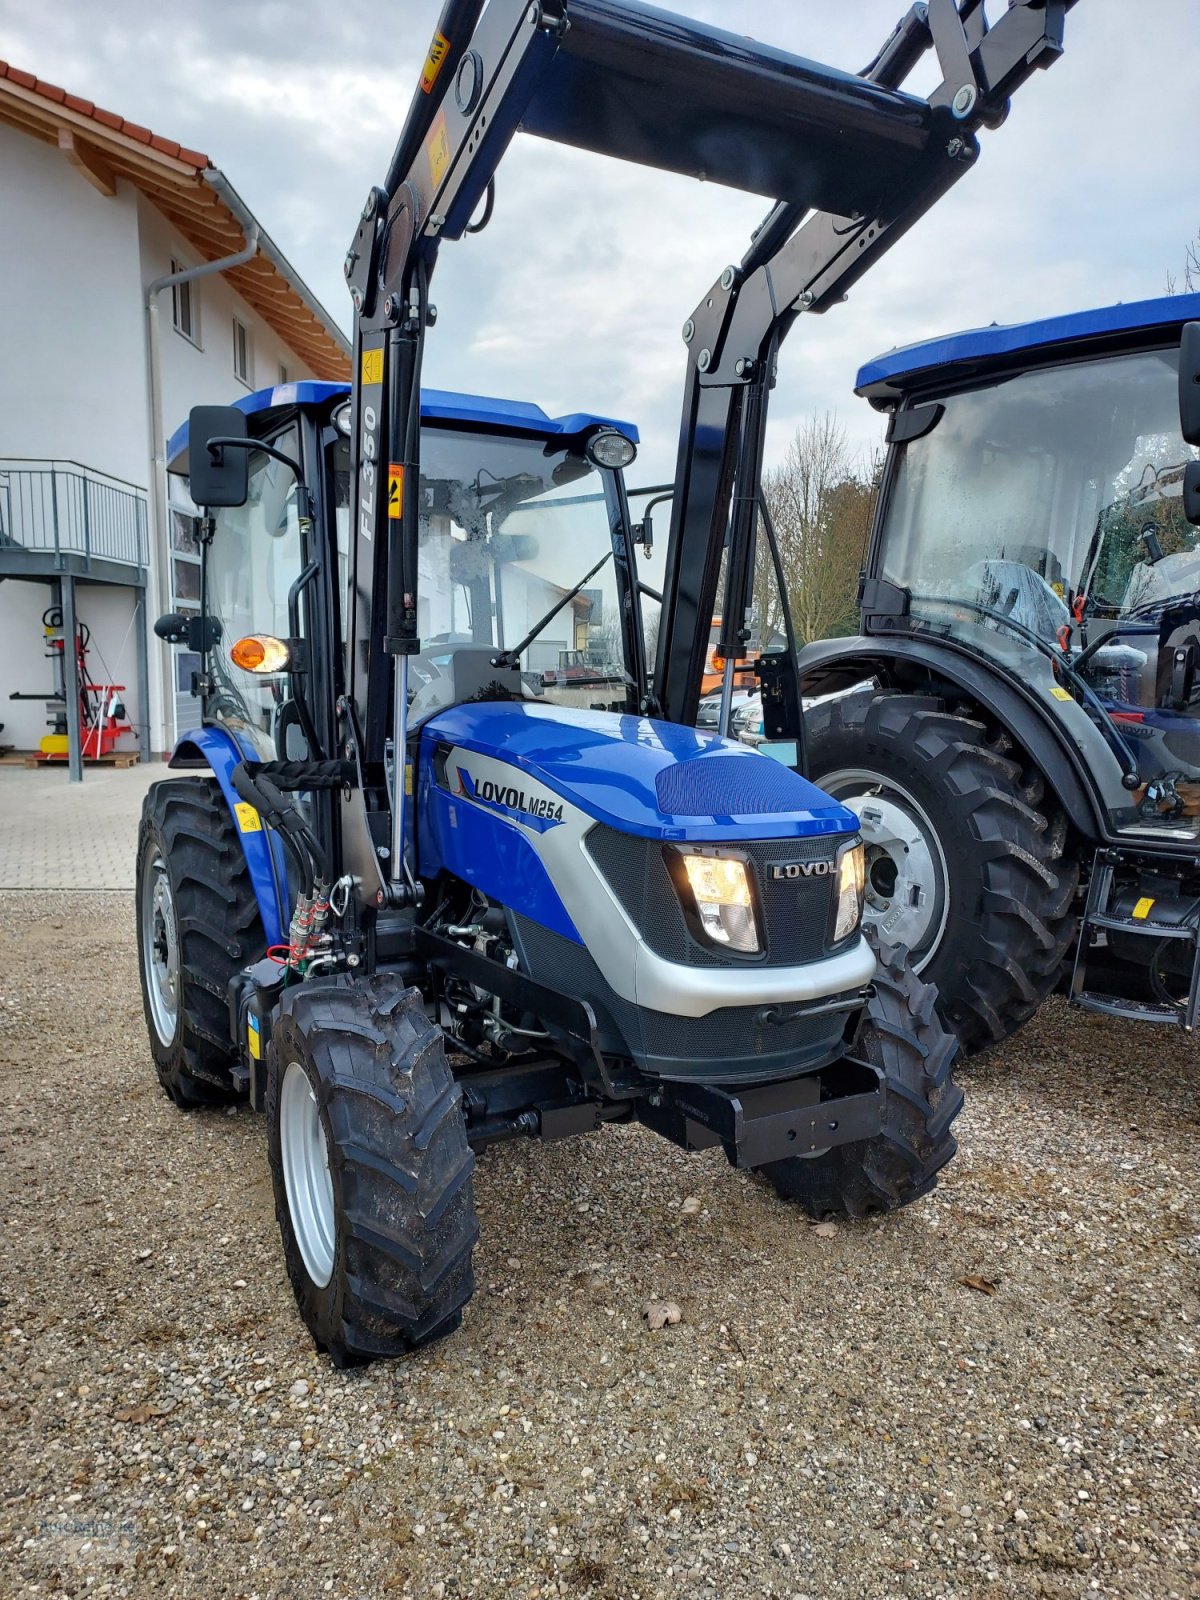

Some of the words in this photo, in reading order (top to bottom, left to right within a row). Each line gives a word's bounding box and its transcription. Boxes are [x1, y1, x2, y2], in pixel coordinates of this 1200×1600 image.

[473, 778, 528, 812] LOVOL
[528, 796, 564, 822] M254
[772, 861, 838, 880] LOVOL
